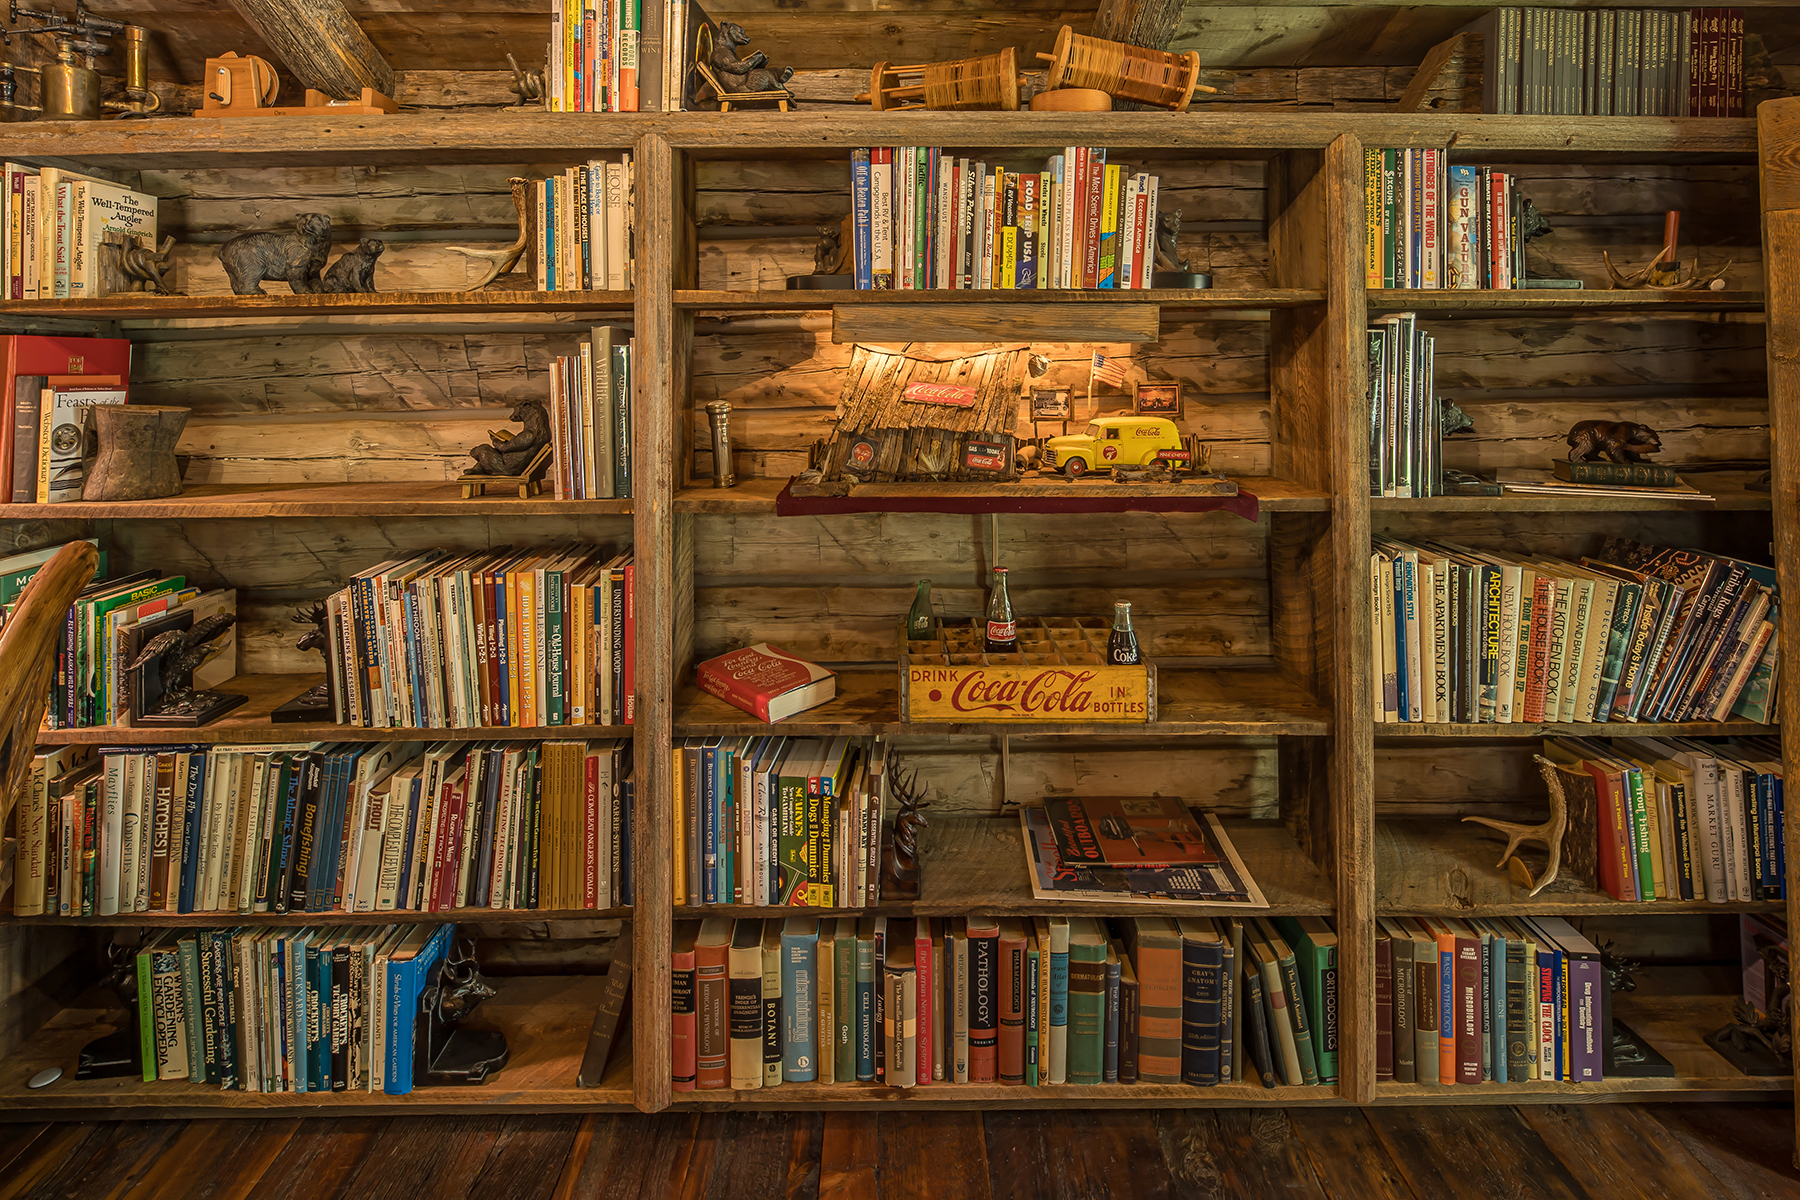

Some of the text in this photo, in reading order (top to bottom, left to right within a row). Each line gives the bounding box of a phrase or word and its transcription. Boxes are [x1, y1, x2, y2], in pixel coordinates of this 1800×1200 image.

[91, 197, 154, 217] Well-Tempered
[122, 195, 139, 206] The
[611, 168, 620, 208] HOUSE
[1091, 195, 1100, 216] Scenic
[57, 186, 66, 263] What the Trout Said
[111, 212, 142, 227] Angler
[1023, 180, 1034, 263] ROAD TRIP USA
[1090, 217, 1099, 238] Drives
[1125, 197, 1134, 242] MONTANA
[1426, 191, 1435, 248] OF THE WORLD
[1460, 187, 1469, 283] GUN VALUES
[1087, 246, 1095, 274] America
[57, 394, 96, 408] Feasts
[596, 358, 608, 404] Wildlife
[1135, 427, 1161, 436] Coca-Cola
[39, 442, 49, 485] Dictionary
[131, 586, 157, 600] BASIC
[1405, 562, 1413, 601] RENOVATION
[1713, 569, 1744, 619] Tribal Rugs
[410, 595, 421, 640] BATHROOM
[613, 589, 622, 651] UNDERSTANDING
[1436, 571, 1446, 702] THE APARTMENT BOOK
[1488, 571, 1502, 660] ARCHITECTURE
[1500, 586, 1515, 678] NEW HOUSE BOOK
[1534, 583, 1549, 685] THE HOUSE BOOK
[1546, 587, 1569, 697] THE KITCHEN BOOK
[1568, 587, 1589, 687] THE BED BATH BOOK
[342, 613, 356, 710] KITCHENS ACCESSORIES
[522, 621, 530, 682] IMPROVEMENT
[552, 634, 562, 697] Old-House Journal
[1113, 649, 1137, 662] Coke
[911, 670, 1099, 713] DRINK Coca-Cola
[1094, 702, 1144, 713] BOTTLES
[1110, 687, 1126, 698] IN
[107, 768, 119, 815] Mayflies
[154, 787, 171, 848] HATCHES
[187, 765, 198, 814] The Dry Fly
[371, 797, 384, 832] TROUT
[30, 766, 44, 878] McClane's Standard
[280, 776, 299, 868] The Atlantic Salmon
[296, 803, 316, 878] Bonefishing!
[495, 800, 509, 884] CASTING TECHNIQUES
[808, 799, 819, 877] Dogs Dummies
[821, 796, 832, 883] Managing Dummies
[1066, 800, 1100, 859] OUTBOARDS
[1067, 820, 1082, 857] Beautiful
[1635, 784, 1650, 853] Trout Fishing
[1706, 794, 1720, 870] MARKET GURU
[201, 951, 216, 1005] Successful
[295, 965, 303, 1017] BACKYARD
[793, 970, 812, 1043] microbiology
[978, 941, 989, 1023] PATHOLOGY
[1397, 968, 1406, 1029] MICROBIOLOGY
[1542, 967, 1552, 1043] STOPPING THE CLOCK
[154, 978, 168, 1066] ENCYCLOPEDIA
[164, 976, 178, 1048] GARDENING
[204, 1007, 217, 1064] Gardening
[767, 1002, 776, 1047] BOTANY
[1326, 972, 1337, 1049] ORTHODONTICS
[1443, 984, 1451, 1033] PATHOLOGY
[1465, 986, 1474, 1036] MICROBIOLOGY
